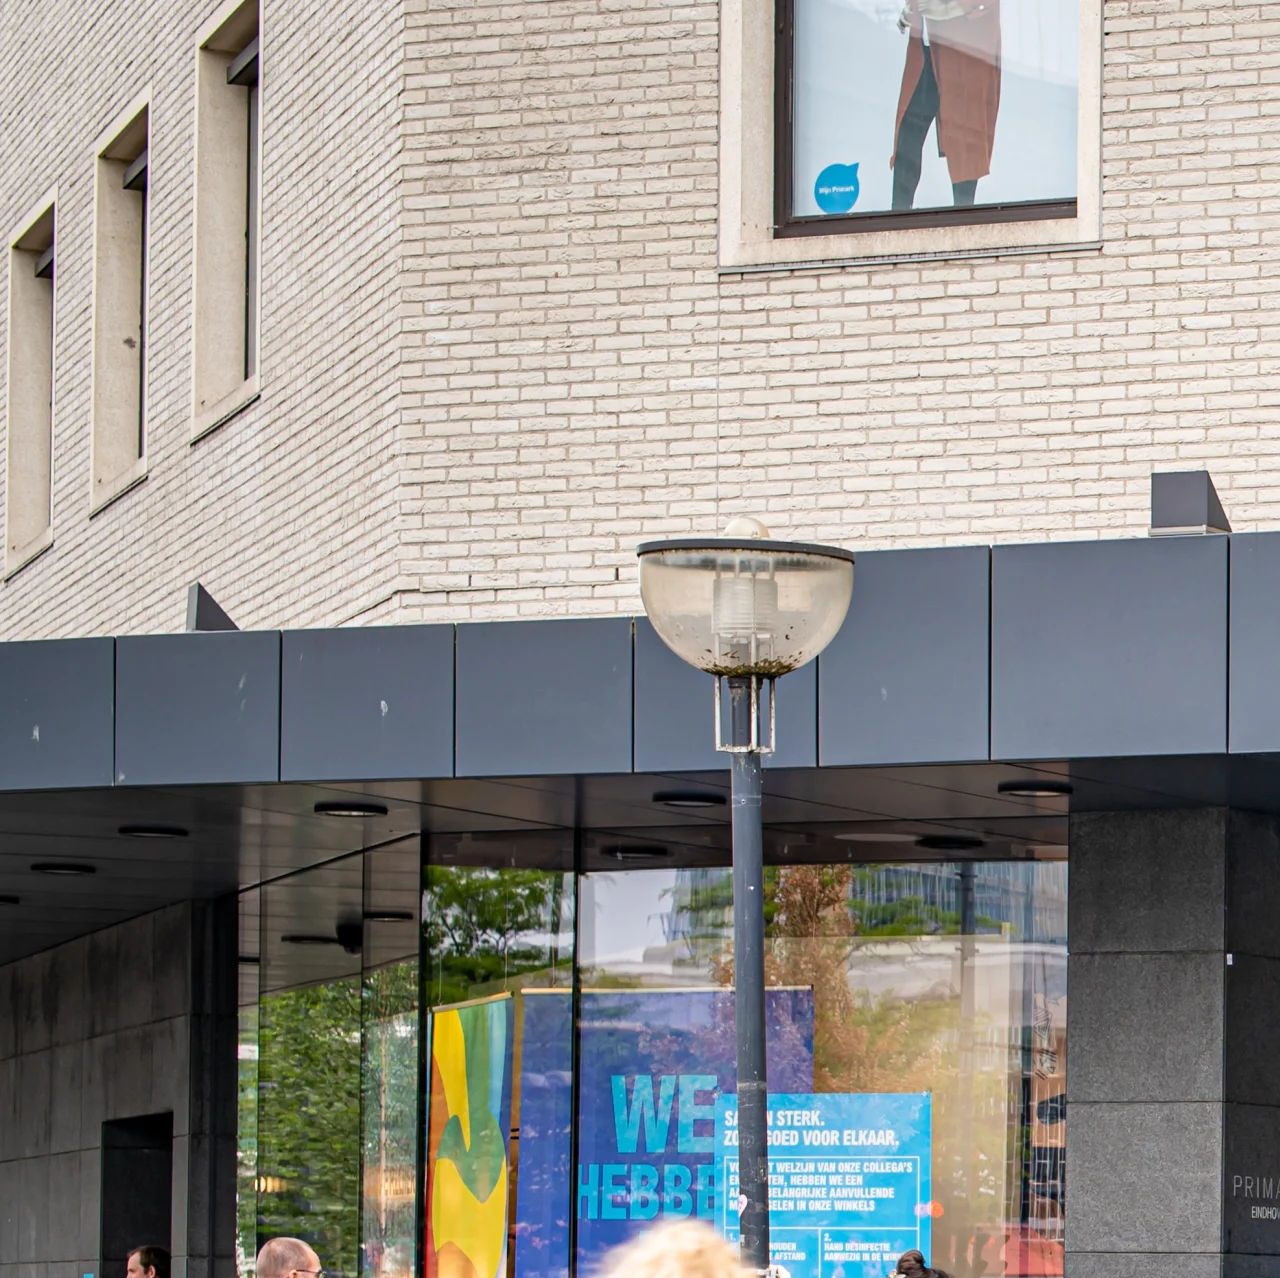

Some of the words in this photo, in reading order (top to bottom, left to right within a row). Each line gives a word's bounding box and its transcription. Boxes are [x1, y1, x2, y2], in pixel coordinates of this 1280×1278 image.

[611, 1074, 718, 1153] WE
[777, 1110, 825, 1127] STERK.
[802, 1130, 840, 1146] VOOR
[843, 1130, 900, 1146] ELKAAR.
[776, 1162, 815, 1173] WELZIJN
[817, 1162, 836, 1173] VAN
[838, 1162, 861, 1173] ONZE
[790, 1175, 826, 1186] HEBBEN
[828, 1175, 843, 1186] WE
[845, 1175, 863, 1186] EEN
[577, 1163, 716, 1220] HEBBE
[829, 1188, 895, 1199] AANVULLENDE
[797, 1200, 806, 1211] IN
[808, 1200, 833, 1211] ONZE
[835, 1200, 876, 1211] WINKELS
[824, 1233, 832, 1242] 2.
[845, 1242, 891, 1252] DESINFECTIE
[871, 1252, 881, 1261] DE
